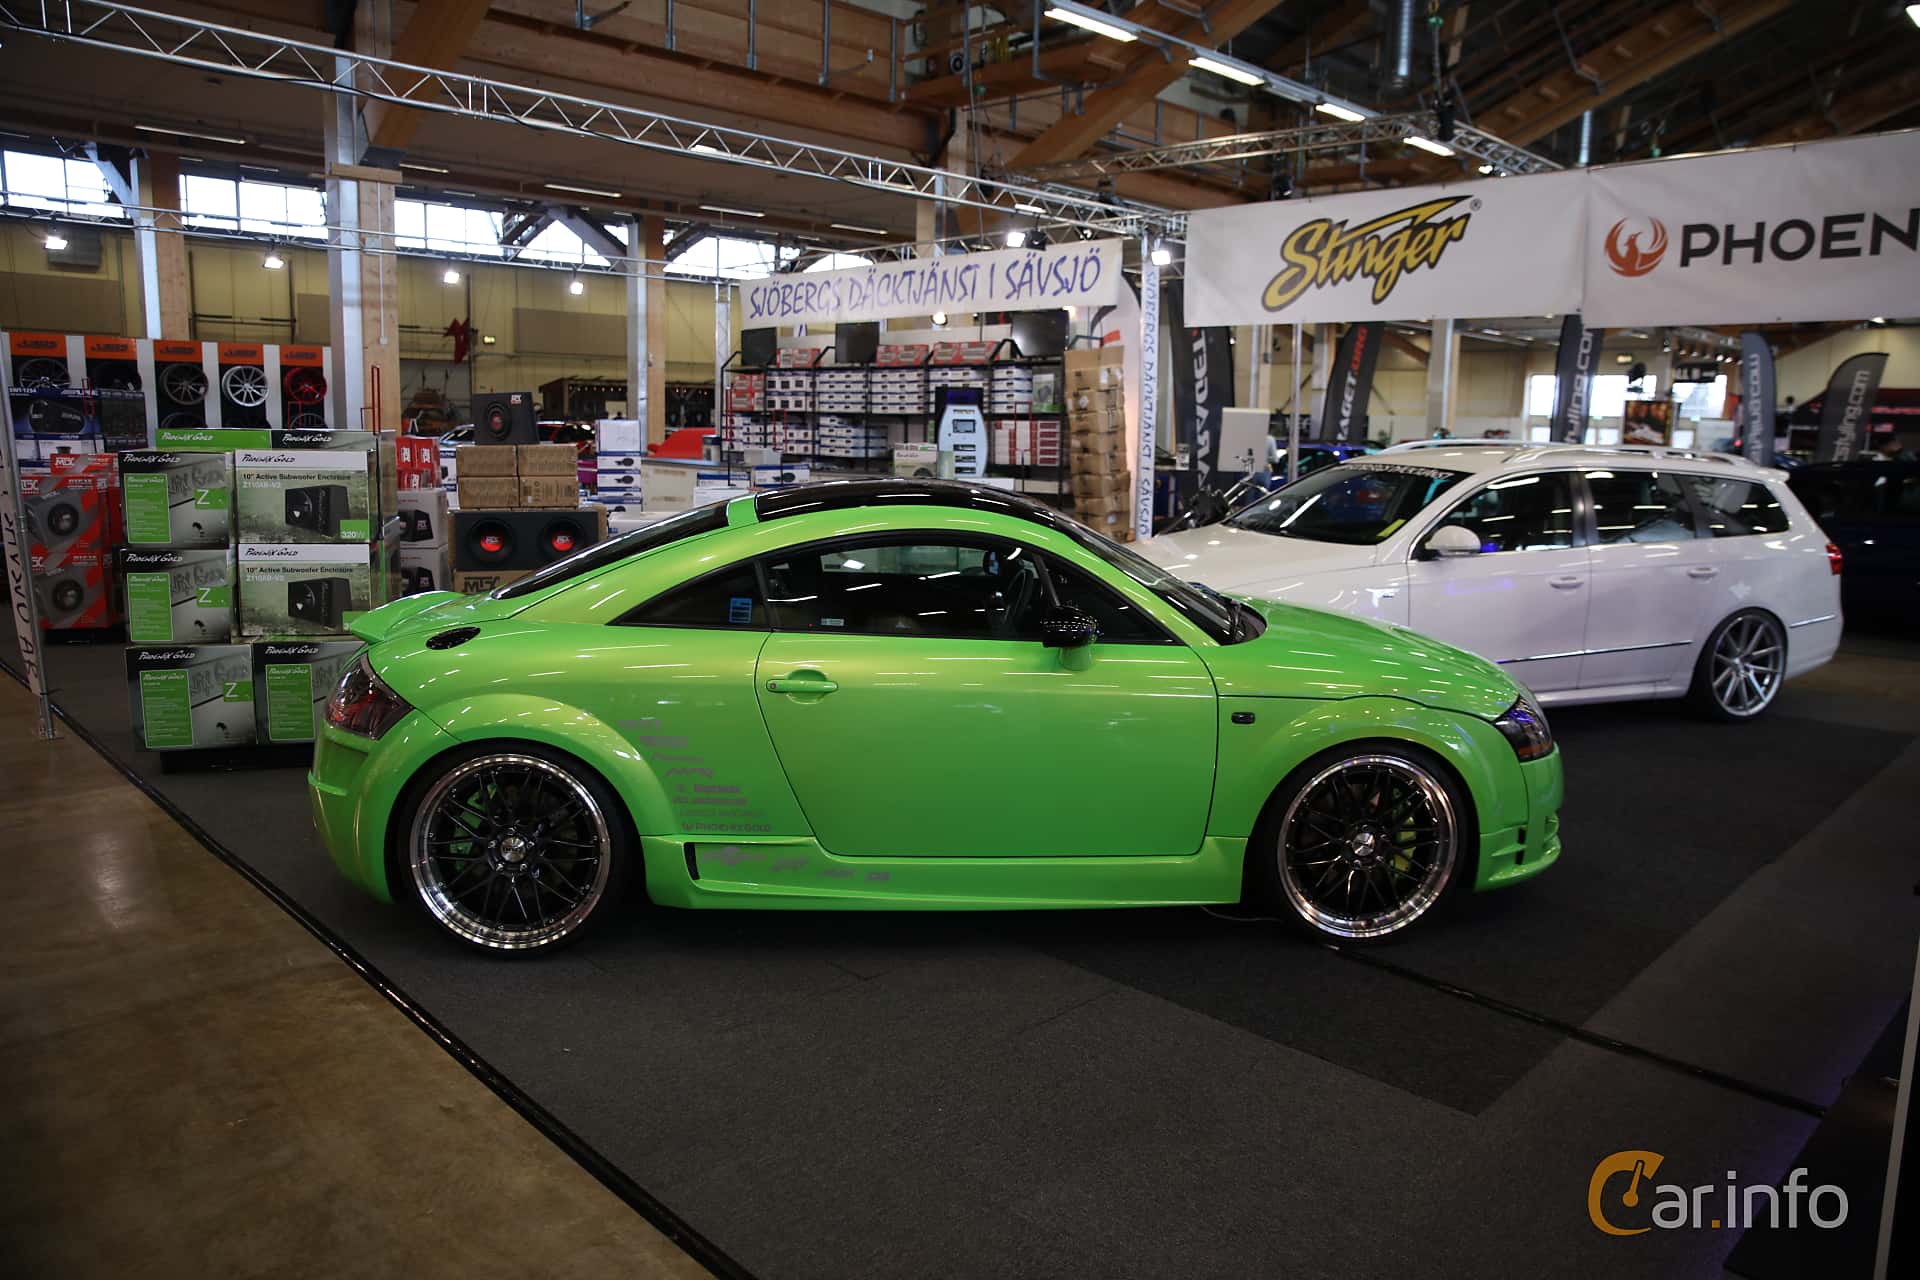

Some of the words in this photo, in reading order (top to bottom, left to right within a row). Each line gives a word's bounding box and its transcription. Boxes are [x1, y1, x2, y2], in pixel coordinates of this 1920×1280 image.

[1262, 195, 1473, 311] Stinger
[750, 277, 843, 319] SJÖBERGS
[849, 261, 981, 310] DÄCKTJÄNST
[989, 264, 996, 299] I
[1005, 248, 1102, 299] SÄVSJÖ
[196, 489, 210, 505] Z
[198, 587, 212, 603] Z
[224, 682, 239, 698] Z
